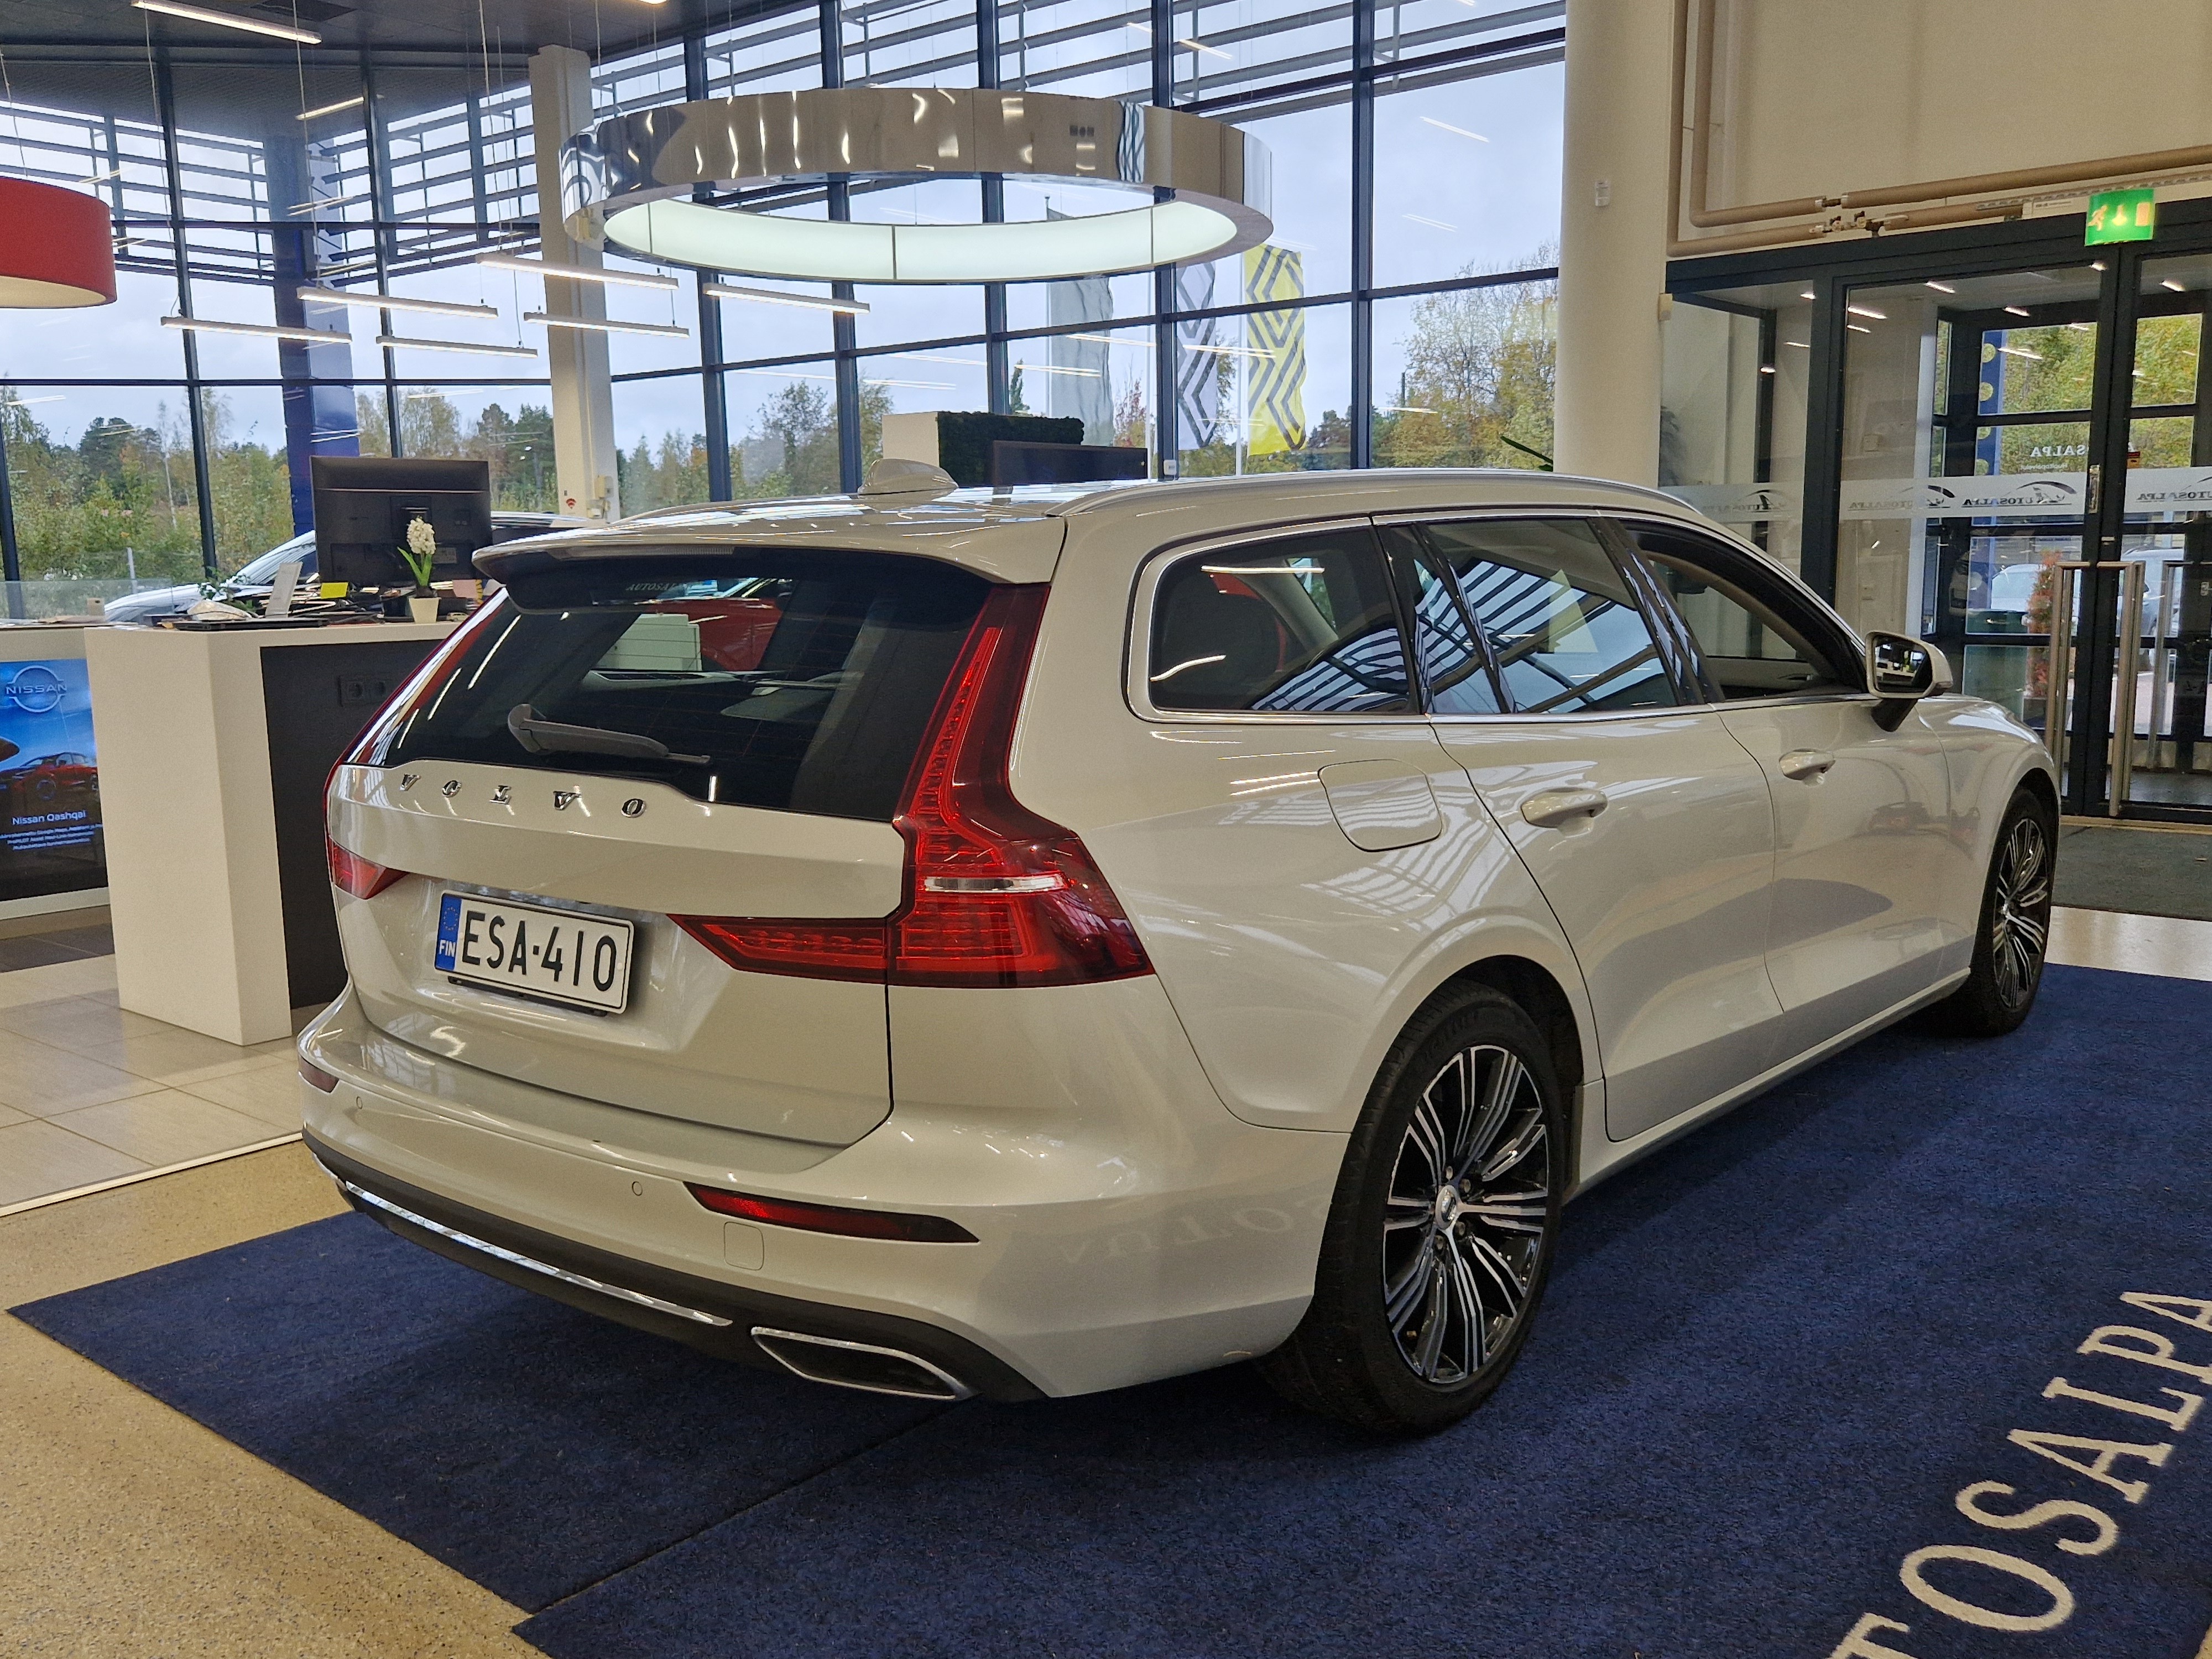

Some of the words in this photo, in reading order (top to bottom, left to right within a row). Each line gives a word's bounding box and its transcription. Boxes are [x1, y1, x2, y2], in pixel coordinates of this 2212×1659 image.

[6, 684, 67, 695] NISSAN
[400, 773, 648, 818] VOLVO
[12, 815, 45, 825] Nissan
[46, 810, 86, 822] Qashqai
[439, 940, 456, 958] FIN
[462, 909, 618, 993] ESA-410
